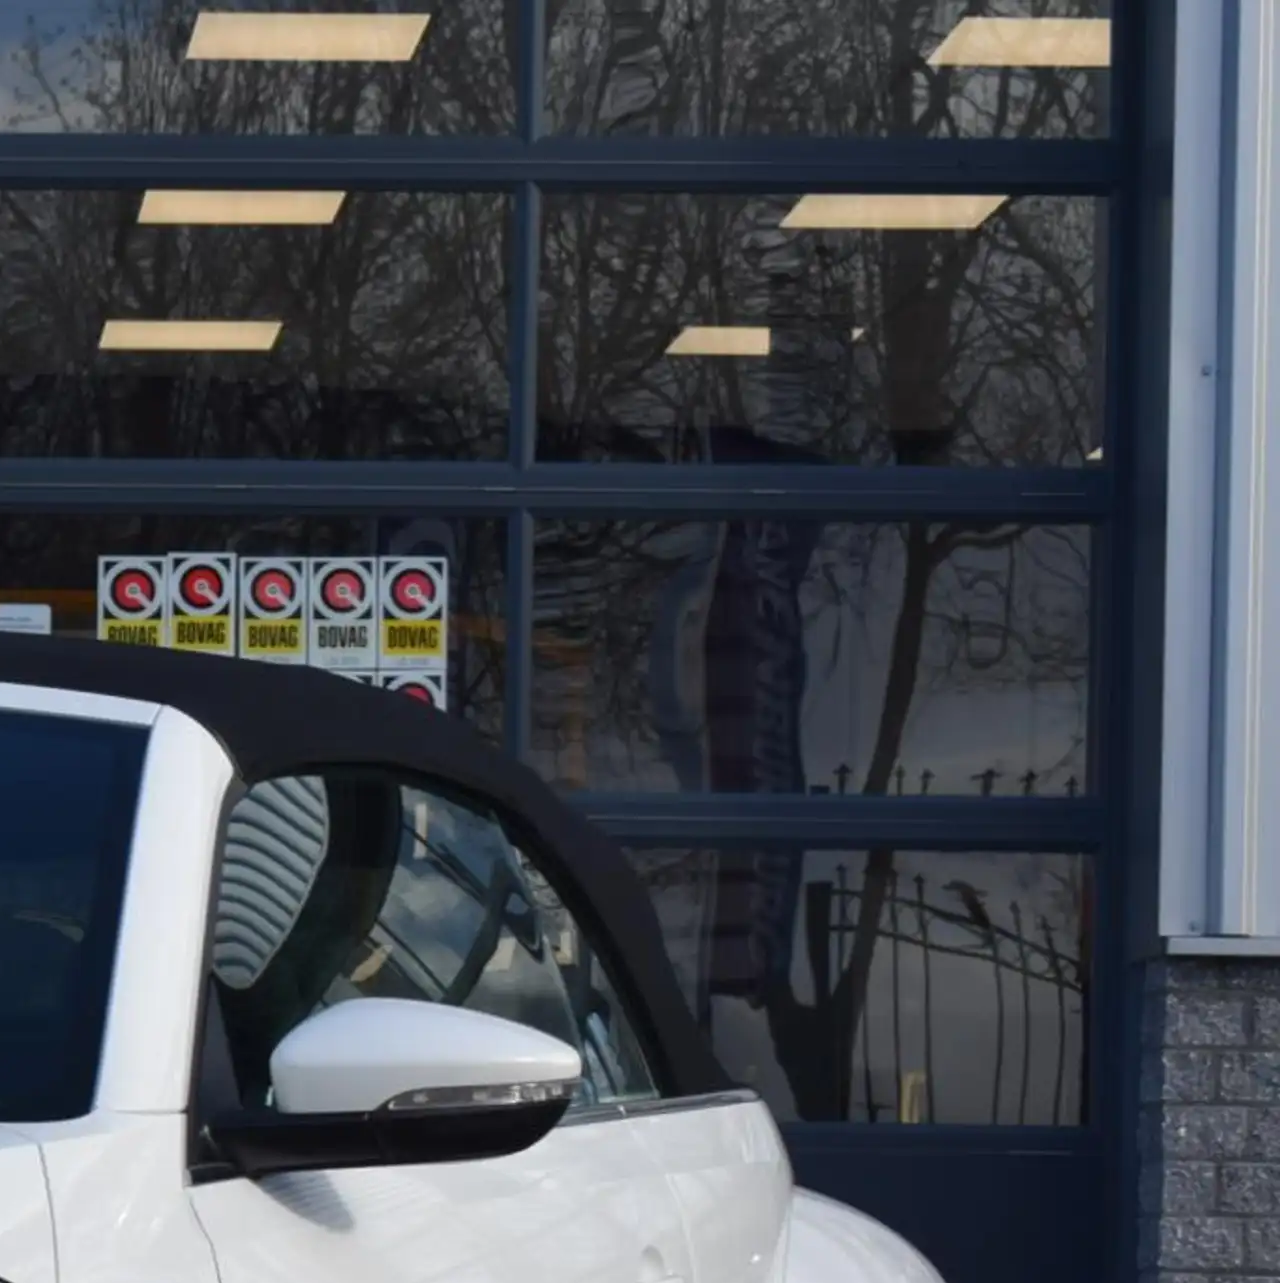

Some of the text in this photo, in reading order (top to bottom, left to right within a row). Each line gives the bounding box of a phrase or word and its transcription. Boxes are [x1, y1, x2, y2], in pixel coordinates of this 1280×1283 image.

[177, 623, 227, 645] BOVAG
[248, 626, 298, 648] BOVAG
[318, 626, 368, 648] BOVAG
[387, 626, 438, 650] BOVAG
